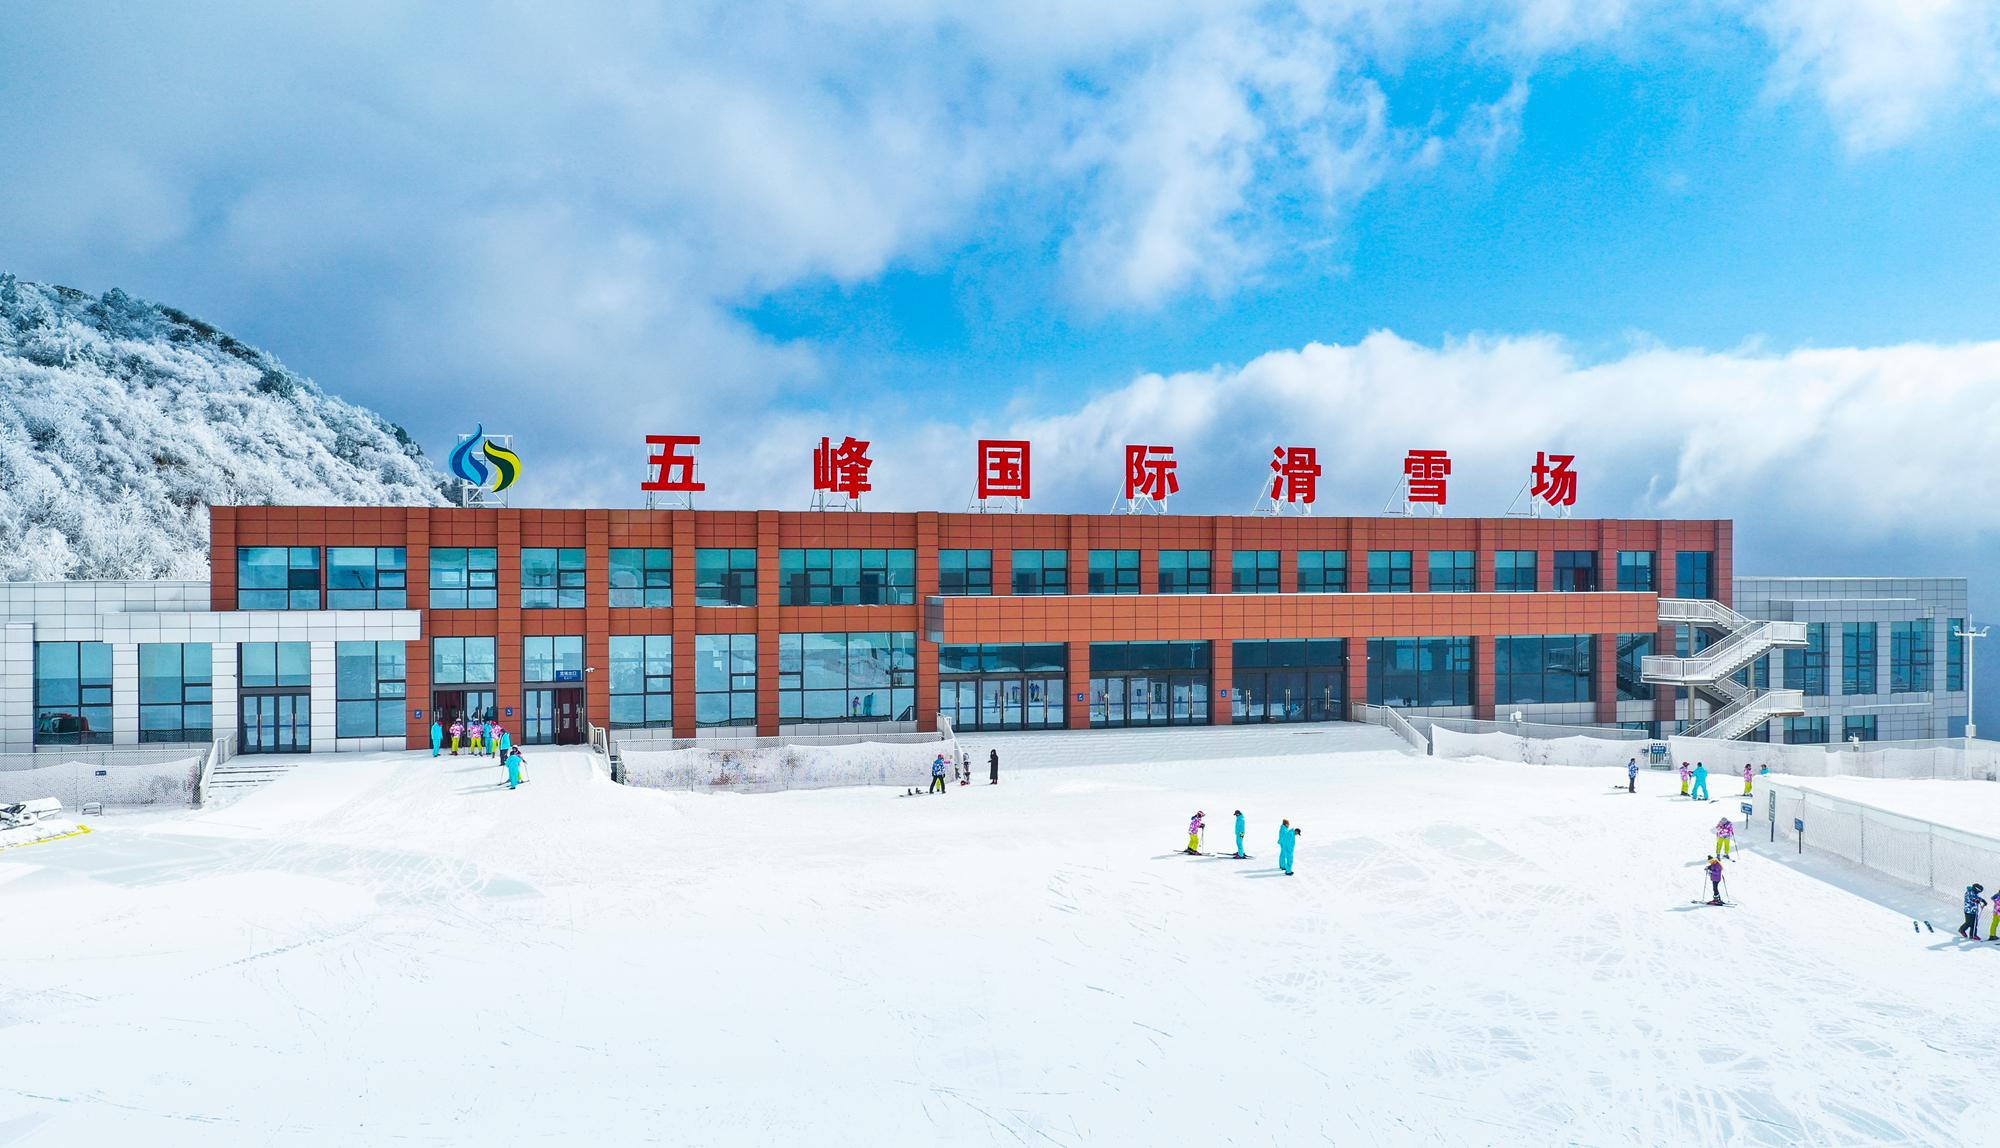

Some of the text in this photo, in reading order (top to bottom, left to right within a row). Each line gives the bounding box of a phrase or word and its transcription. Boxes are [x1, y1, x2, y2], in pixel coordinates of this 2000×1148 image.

[641, 435, 1578, 506] 五峰国际滑雪场
